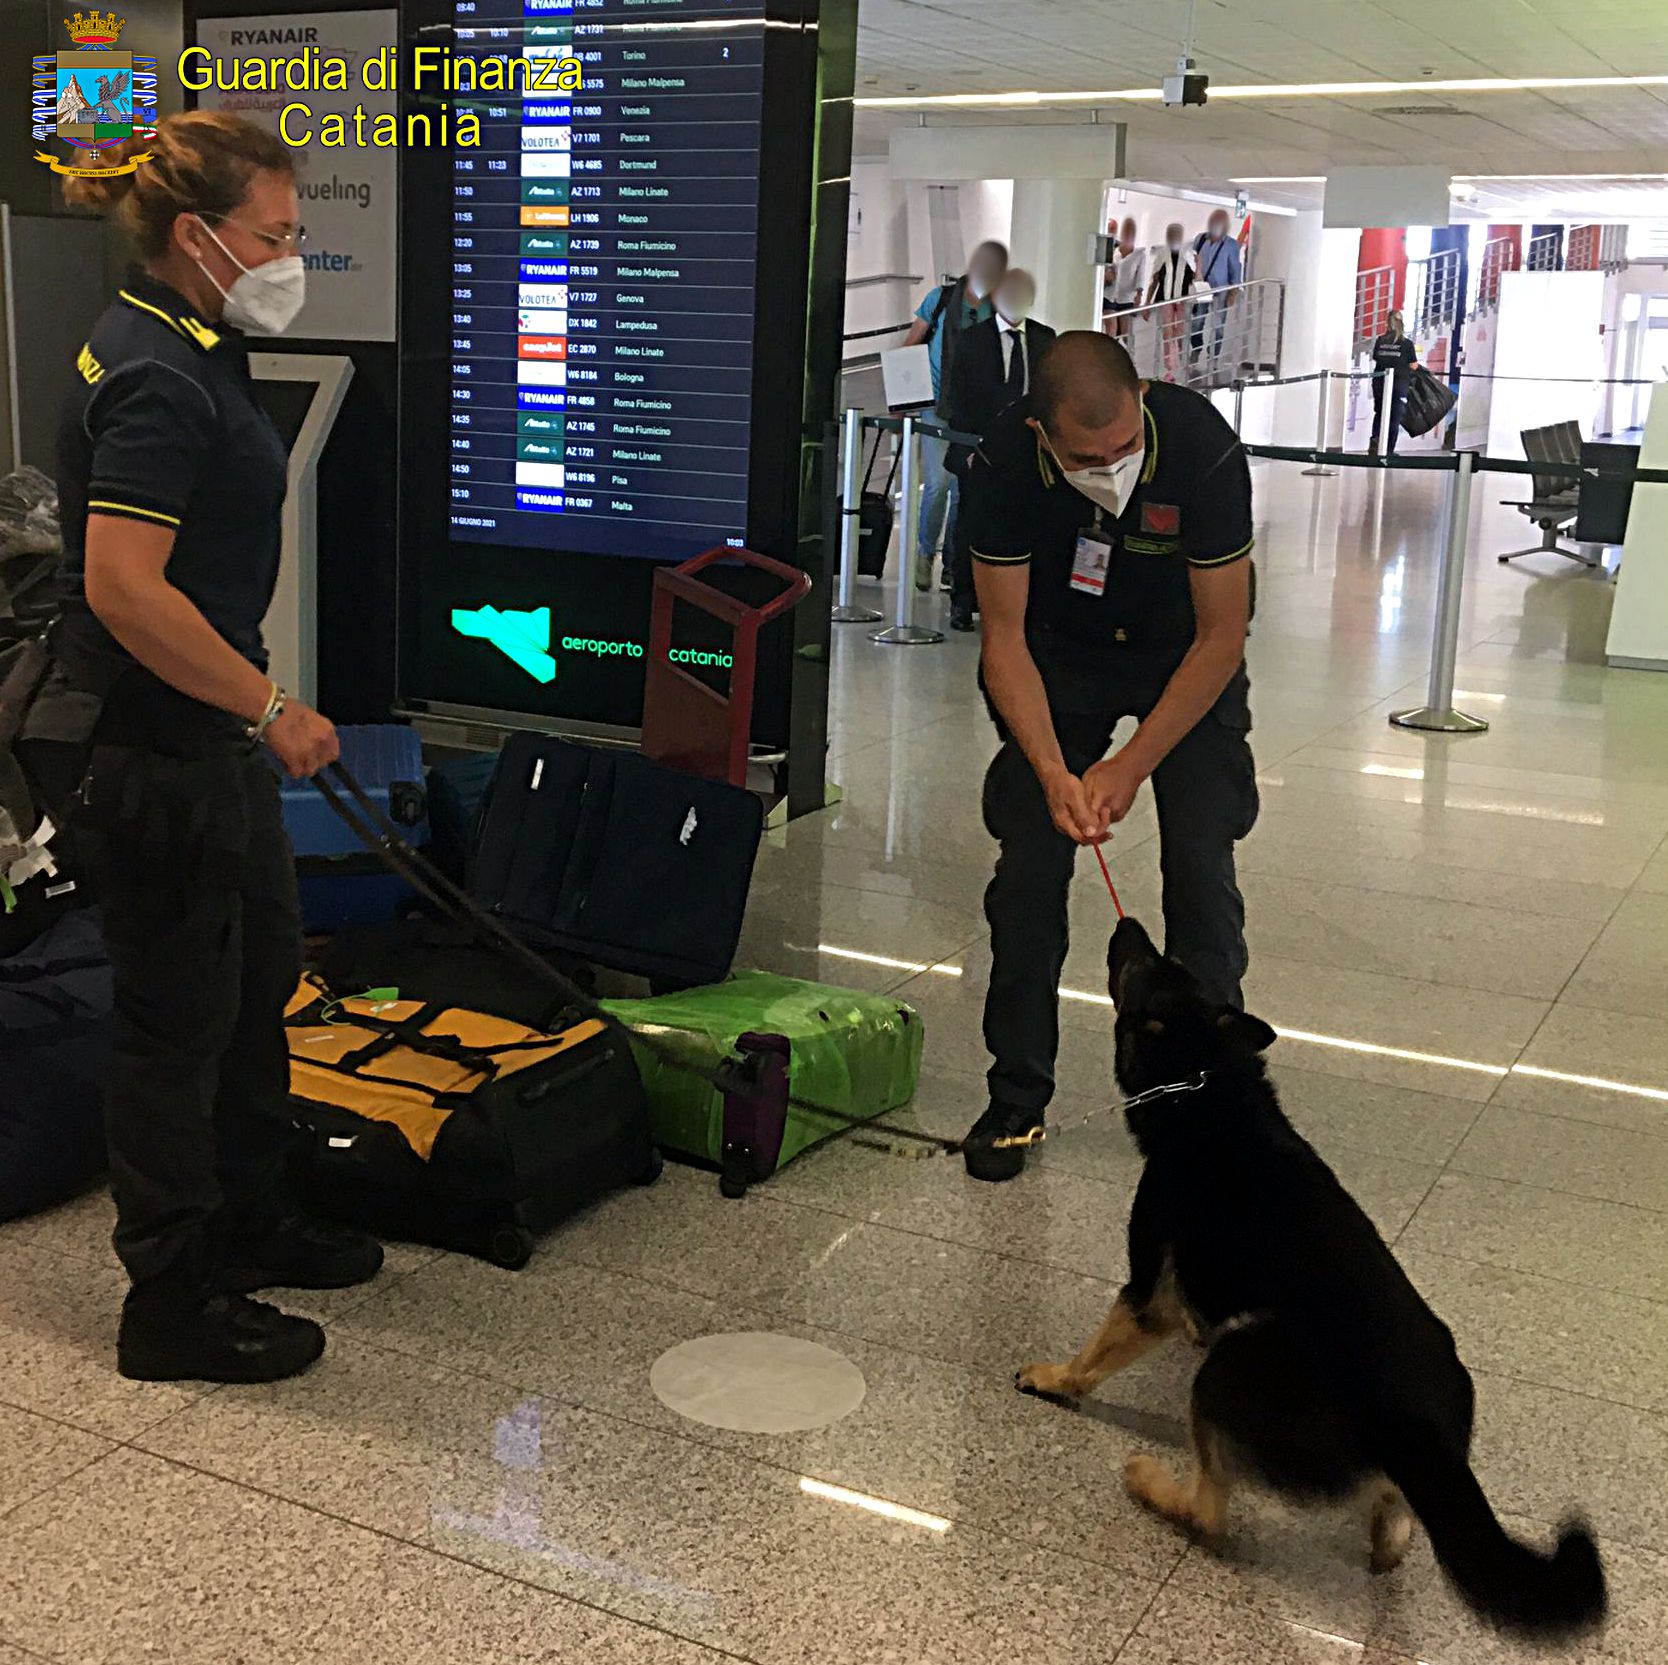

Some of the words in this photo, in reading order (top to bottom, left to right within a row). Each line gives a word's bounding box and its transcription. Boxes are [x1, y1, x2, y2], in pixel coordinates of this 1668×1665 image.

[531, 0, 572, 10] RYANAIR
[231, 27, 318, 45] RYANAIR
[622, 50, 646, 60] Torino
[722, 47, 729, 58] 2
[622, 78, 646, 88] Milano
[648, 78, 686, 89] Malpensa
[529, 106, 570, 118] RYANAIR
[573, 106, 583, 116] FR
[621, 106, 650, 116] Venezia
[522, 138, 560, 148] VOLOTEA
[573, 134, 582, 142] V7
[620, 133, 650, 142] Pescara
[619, 160, 657, 170] Dortmund
[571, 187, 582, 196] AZ
[618, 187, 644, 196] Milano
[645, 187, 669, 196] Linate
[570, 214, 581, 222] LH
[618, 214, 648, 223] Monaco
[570, 240, 581, 249] AZ
[618, 240, 639, 250] Roma
[640, 240, 676, 250] Fiumicino
[526, 264, 567, 276] RYANAIR
[570, 266, 580, 275] FR
[580, 266, 598, 276] 5519
[616, 268, 642, 277] Milano
[644, 268, 680, 278] Malpensa
[518, 294, 556, 304] VOLOTEA
[568, 292, 578, 302] V7
[616, 294, 644, 303] Genova
[568, 318, 580, 328] DX
[616, 320, 658, 331] Lampedusa
[568, 344, 578, 354] EC
[615, 346, 640, 356] Milano
[641, 347, 664, 357] Linate
[567, 370, 580, 379] W6
[614, 372, 644, 383] Bologna
[524, 392, 564, 405] RYANAIR
[566, 396, 577, 404] FR
[614, 398, 634, 408] Roma
[636, 400, 672, 410] Fiumicino
[566, 421, 578, 430] AZ
[613, 424, 634, 434] Roma
[635, 425, 672, 436] Fiumicino
[566, 446, 577, 456] AZ
[578, 448, 594, 457] 1721
[612, 450, 638, 460] Milano
[638, 450, 662, 462] Linate
[452, 464, 470, 474] 14:50
[566, 472, 578, 481] W6
[612, 475, 628, 485] Pisa
[452, 488, 470, 498] 15:10
[522, 493, 562, 506] RYANAIR
[564, 498, 575, 506] FR
[611, 501, 633, 511] Malta
[562, 636, 644, 658] aeroporto
[668, 648, 733, 668] catania
